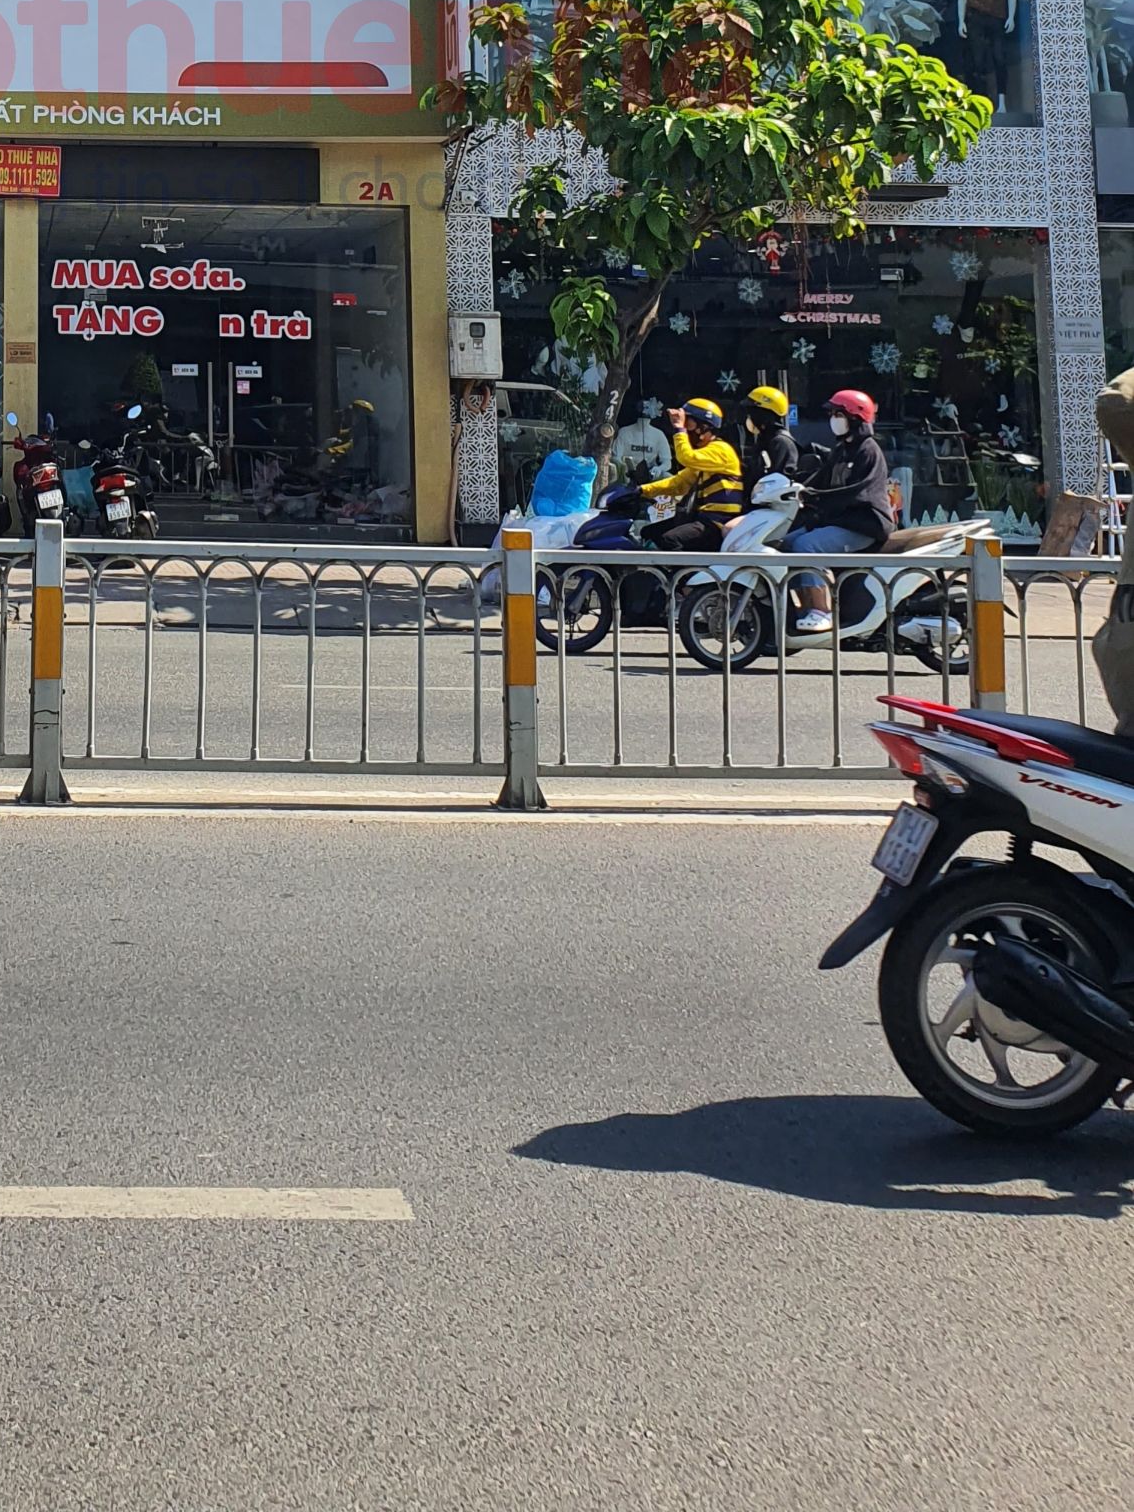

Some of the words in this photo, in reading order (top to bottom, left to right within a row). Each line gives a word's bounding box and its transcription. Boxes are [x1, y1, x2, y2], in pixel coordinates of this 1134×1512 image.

[33, 101, 125, 125] PHÒNG
[132, 101, 221, 126] KHÁCH
[7, 147, 34, 165] THUÊ
[36, 148, 58, 166] NHÀ
[359, 182, 394, 201] 2A
[51, 259, 144, 289] MUA
[149, 258, 246, 291] sofa.
[803, 294, 854, 304] MERRY
[53, 301, 164, 340] TẶNG
[219, 314, 244, 337] n
[251, 309, 311, 339] trà
[797, 313, 882, 325] CHRISTMAS
[1018, 771, 1122, 810] VISION
